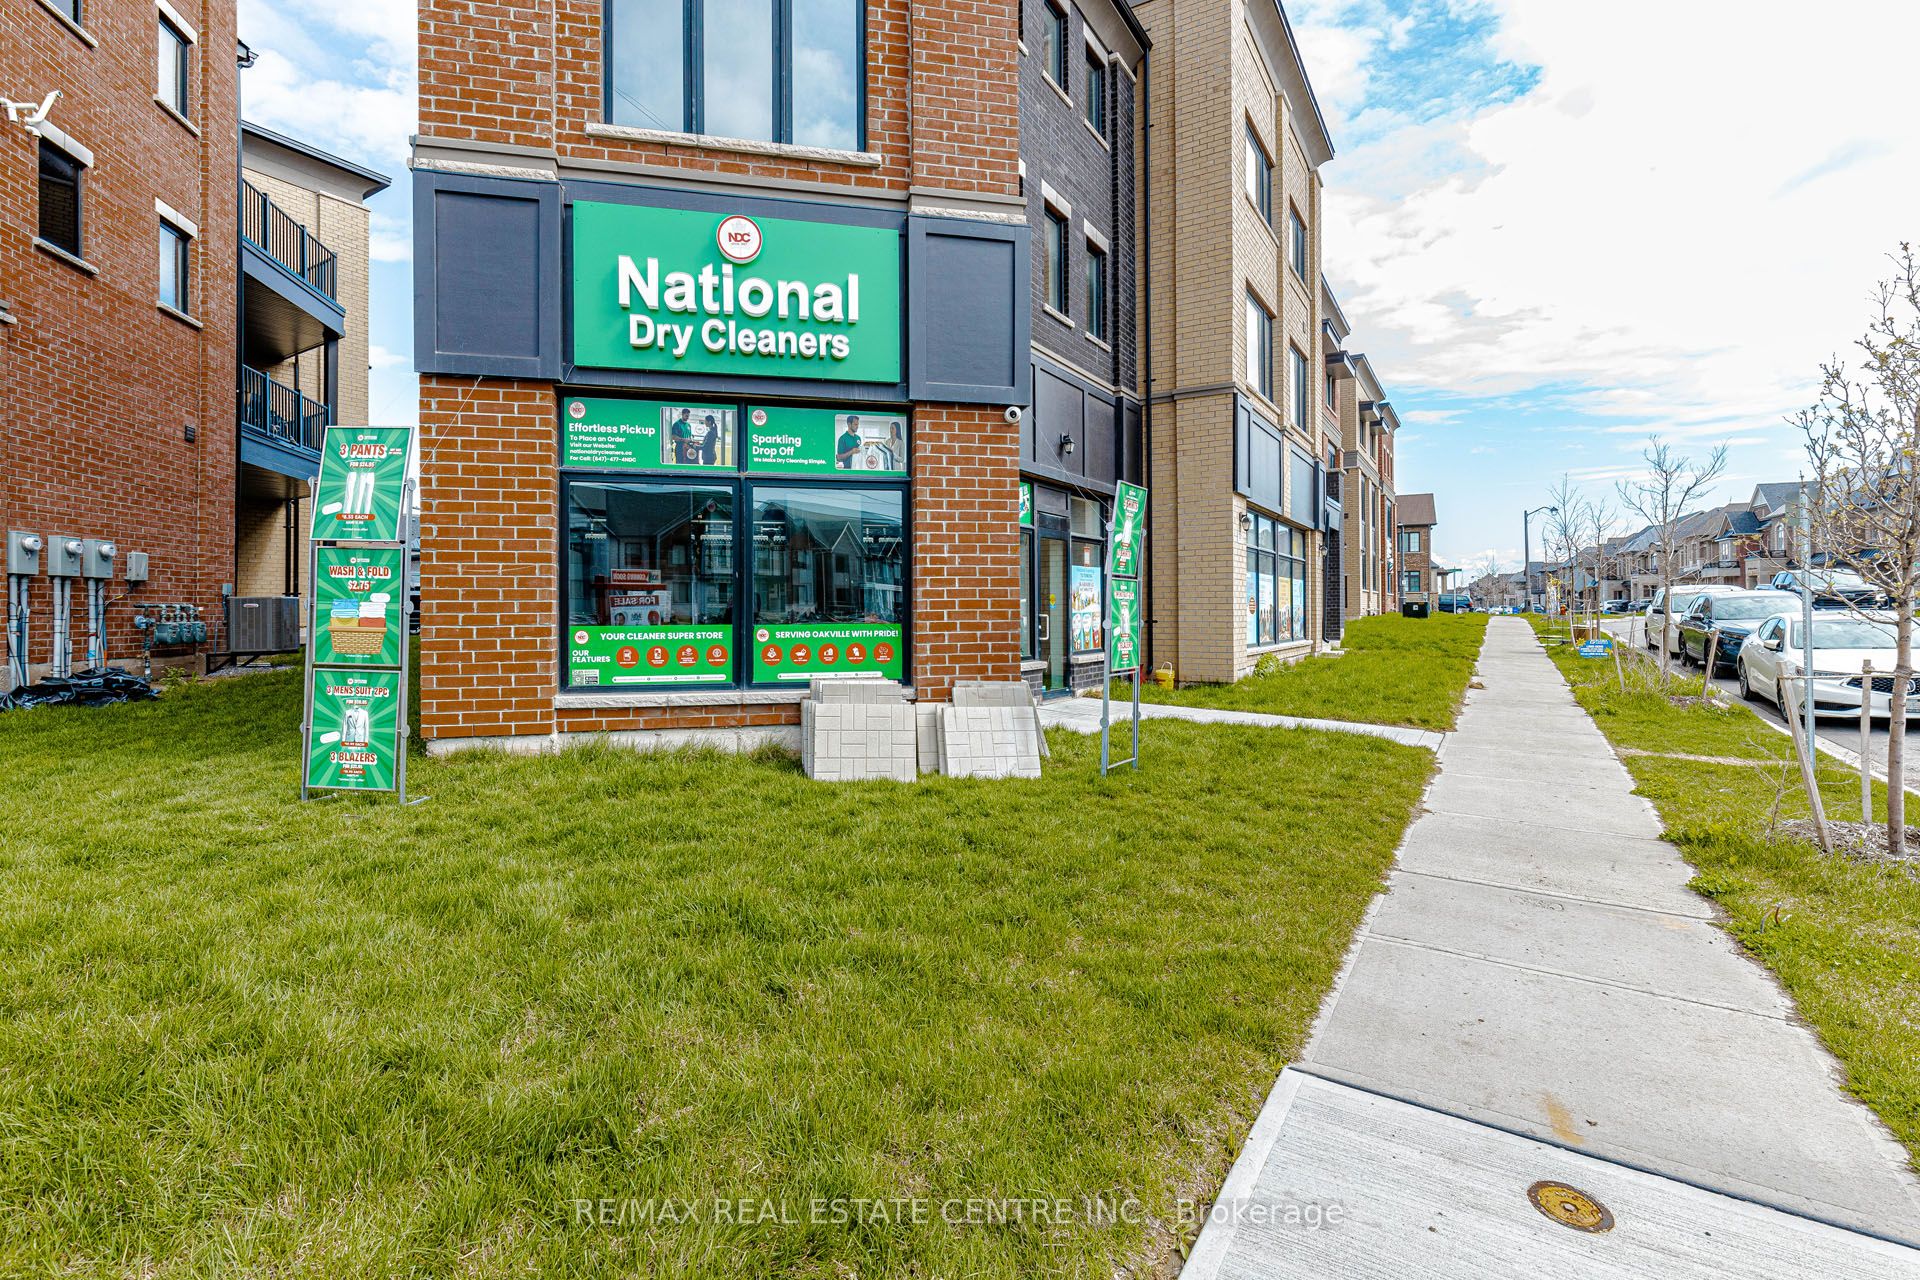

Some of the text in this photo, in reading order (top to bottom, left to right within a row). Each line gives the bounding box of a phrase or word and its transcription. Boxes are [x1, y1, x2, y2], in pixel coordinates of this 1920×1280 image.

[728, 232, 751, 242] NDC
[617, 254, 860, 324] National
[629, 314, 850, 360] Dry Cleaners
[568, 422, 656, 437] Effortless Pickup
[752, 434, 802, 447] Sparkling
[340, 444, 348, 458] 3
[350, 444, 386, 458] PANTS
[752, 446, 794, 458] Drop Off
[329, 566, 390, 578] WASH & FOLD
[348, 580, 370, 591] $2.75
[600, 632, 625, 640] YOUR
[628, 632, 666, 640] CLEANER
[326, 686, 389, 697] 3 MENS SUIT 2PC
[330, 752, 376, 764] 3 BLAZERS
